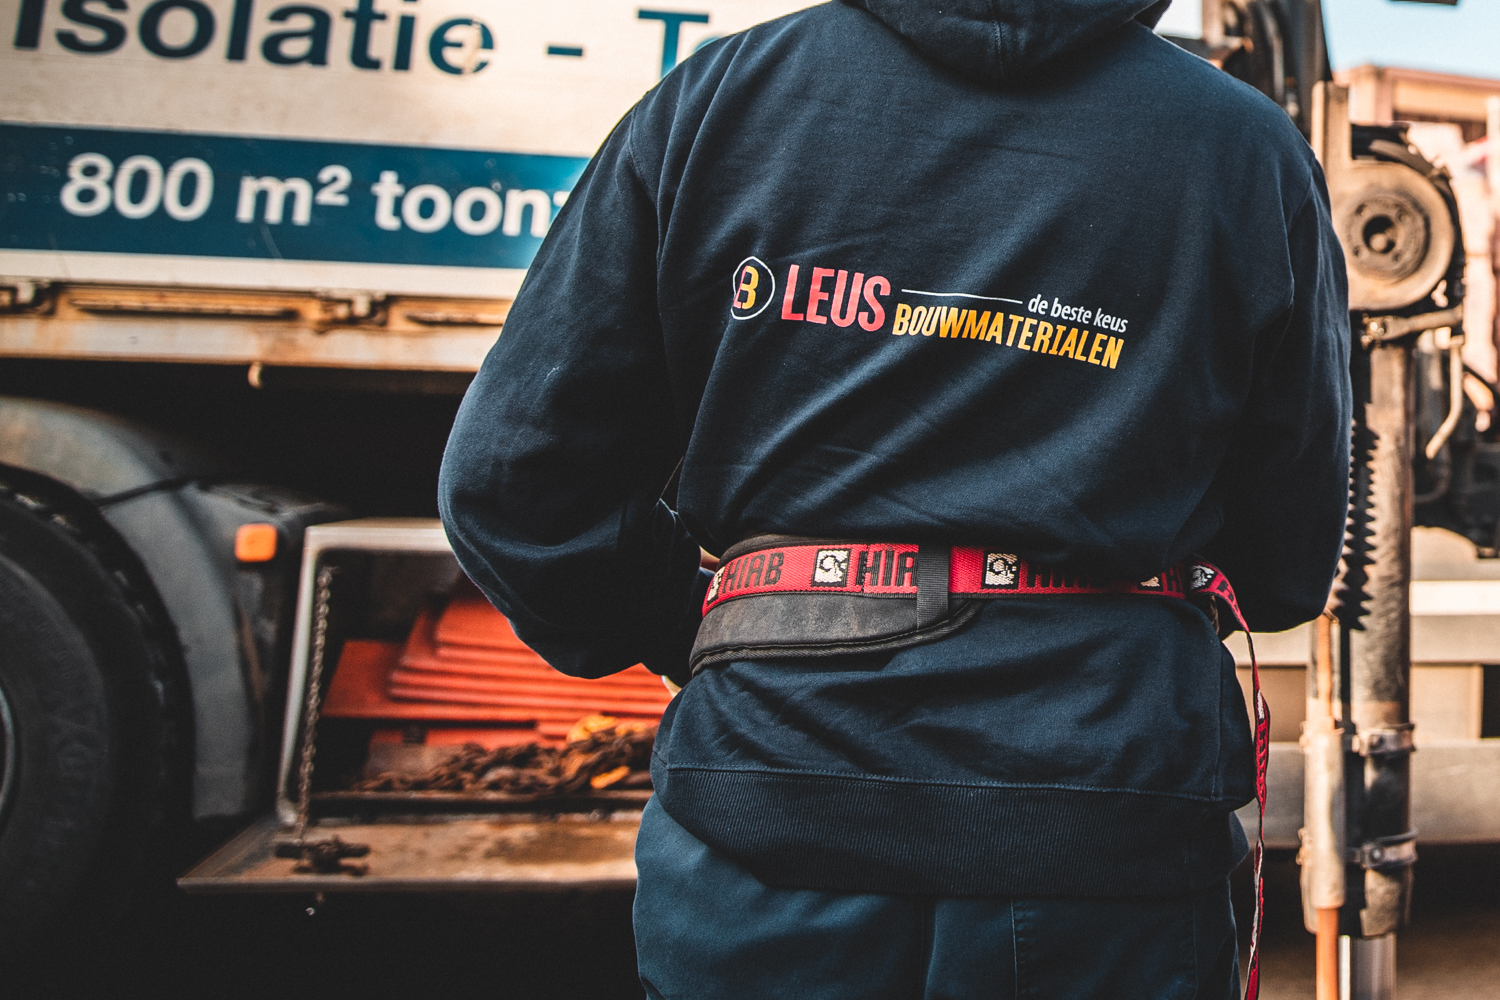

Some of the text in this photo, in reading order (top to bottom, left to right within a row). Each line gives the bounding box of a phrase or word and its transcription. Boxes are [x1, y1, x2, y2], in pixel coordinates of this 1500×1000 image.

[638, 9, 723, 79] T
[60, 152, 214, 222] 800
[372, 170, 571, 238] toon
[781, 264, 891, 332] LEUS
[1027, 294, 1128, 333] de beste keus
[892, 303, 1125, 370] BOUWMATERIALEN
[722, 552, 785, 594] HIAB
[855, 550, 919, 588] HIA
